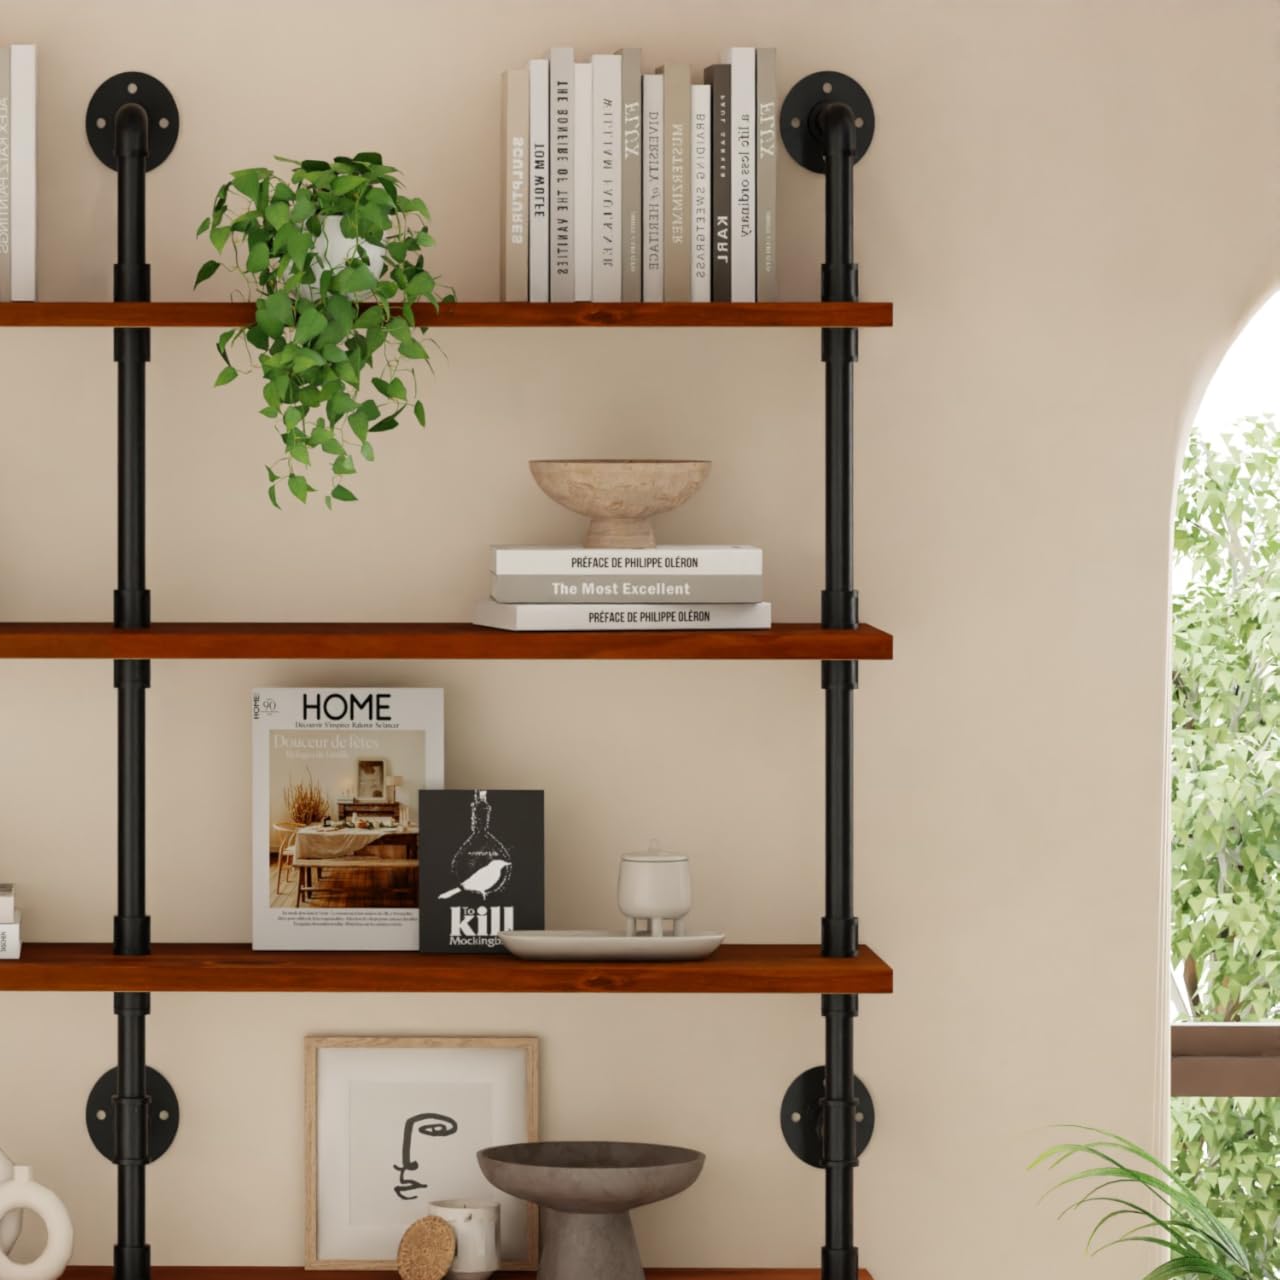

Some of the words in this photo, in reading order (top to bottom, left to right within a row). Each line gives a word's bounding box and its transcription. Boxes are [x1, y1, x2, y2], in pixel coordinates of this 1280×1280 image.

[571, 556, 609, 568] PRÉFACE
[611, 556, 622, 568] DE
[625, 556, 662, 568] PHILIPPE
[665, 556, 699, 568] OLÉRON
[552, 582, 577, 595] The
[581, 582, 619, 595] Most
[623, 582, 690, 595] Excellent
[589, 611, 625, 623] PRÉFACE
[627, 611, 638, 623] DE
[640, 611, 677, 623] PHILIPPE
[678, 611, 710, 623] OLÉRON
[303, 693, 392, 720] HOME
[462, 906, 476, 915] To
[449, 936, 502, 948] Mockingb
